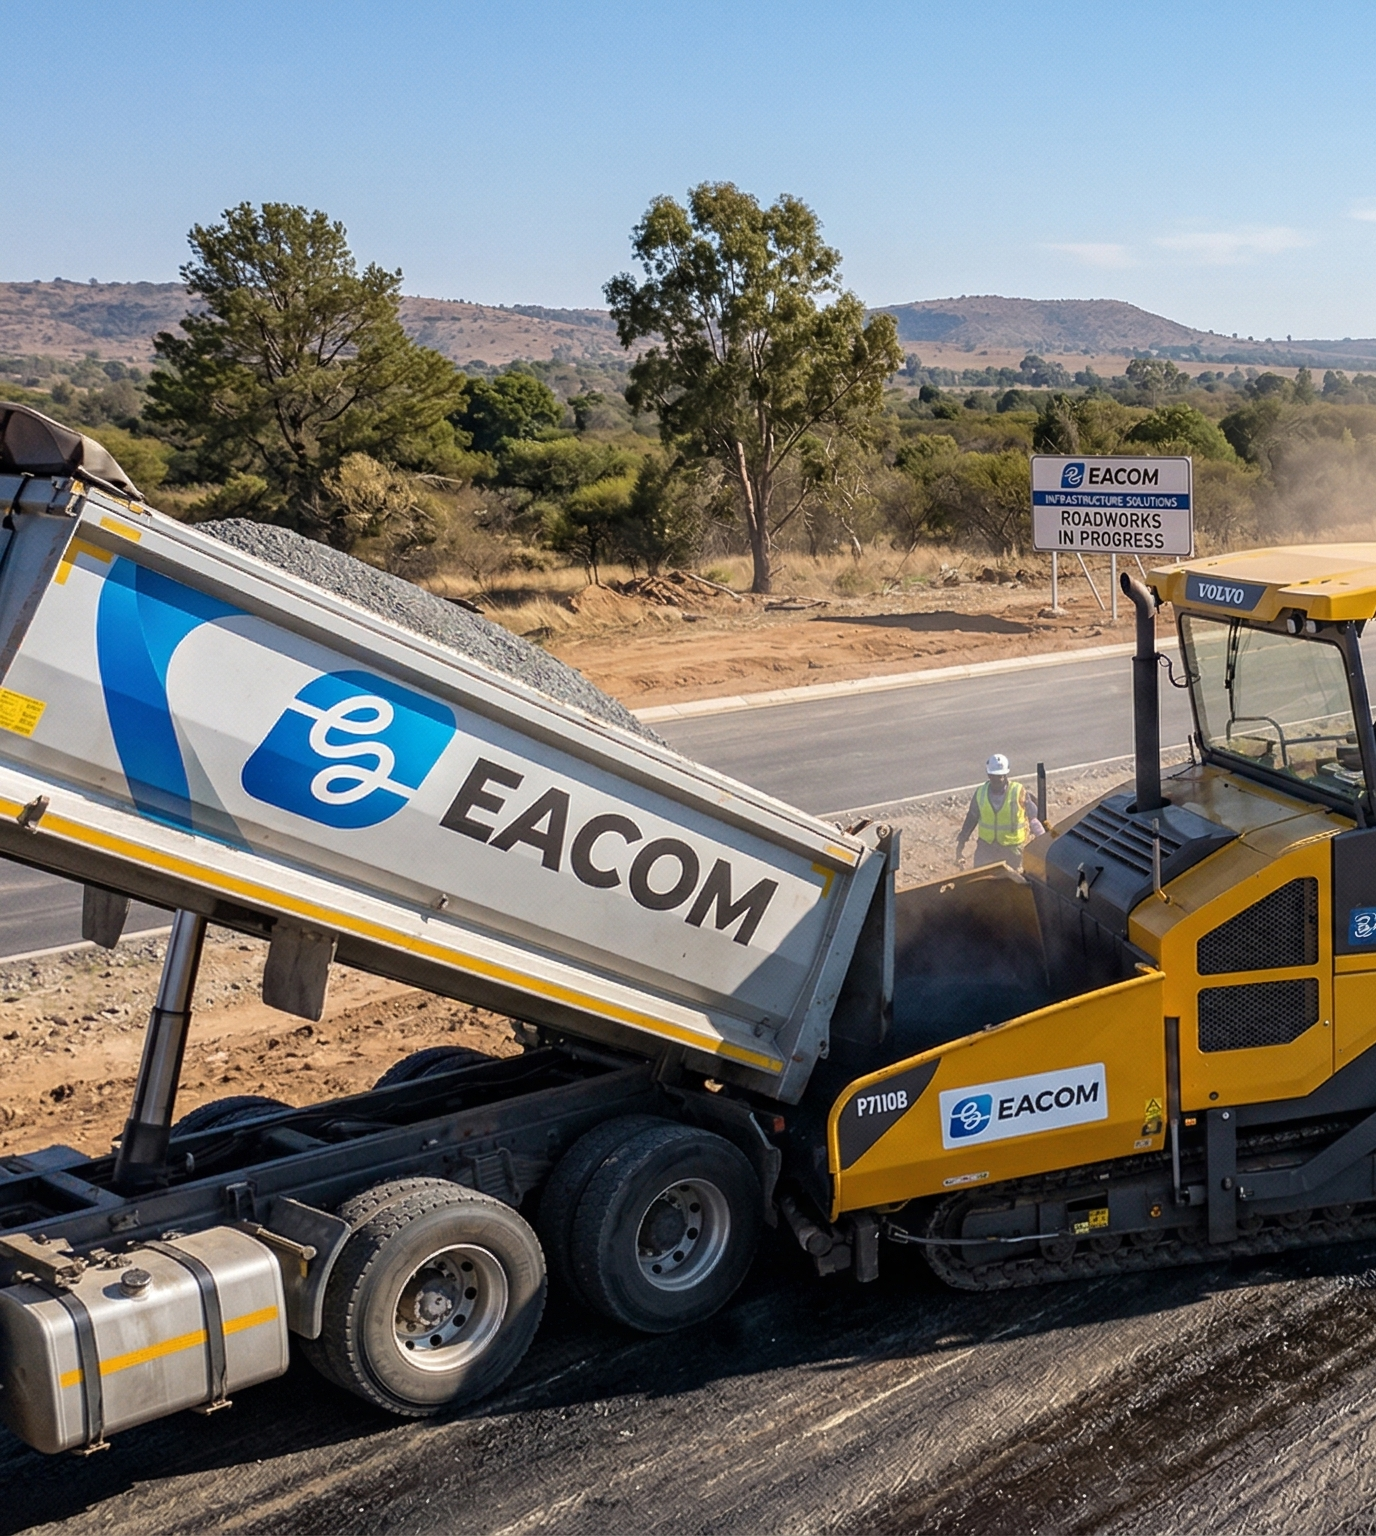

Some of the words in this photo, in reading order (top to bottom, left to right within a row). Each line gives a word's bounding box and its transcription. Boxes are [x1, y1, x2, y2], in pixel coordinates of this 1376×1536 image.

[1088, 467, 1159, 486] EACOM
[1045, 494, 1124, 507] INFRASTRUCTURE
[1126, 496, 1178, 508] SOLUTIONS
[1061, 510, 1162, 529] ROADWORKS
[1058, 530, 1074, 545] IN
[1080, 530, 1165, 549] PROGRESS
[1198, 582, 1245, 605] VOLVO
[438, 756, 779, 947] EACOM
[856, 1090, 909, 1117] P7110B
[997, 1081, 1100, 1121] EACOM
